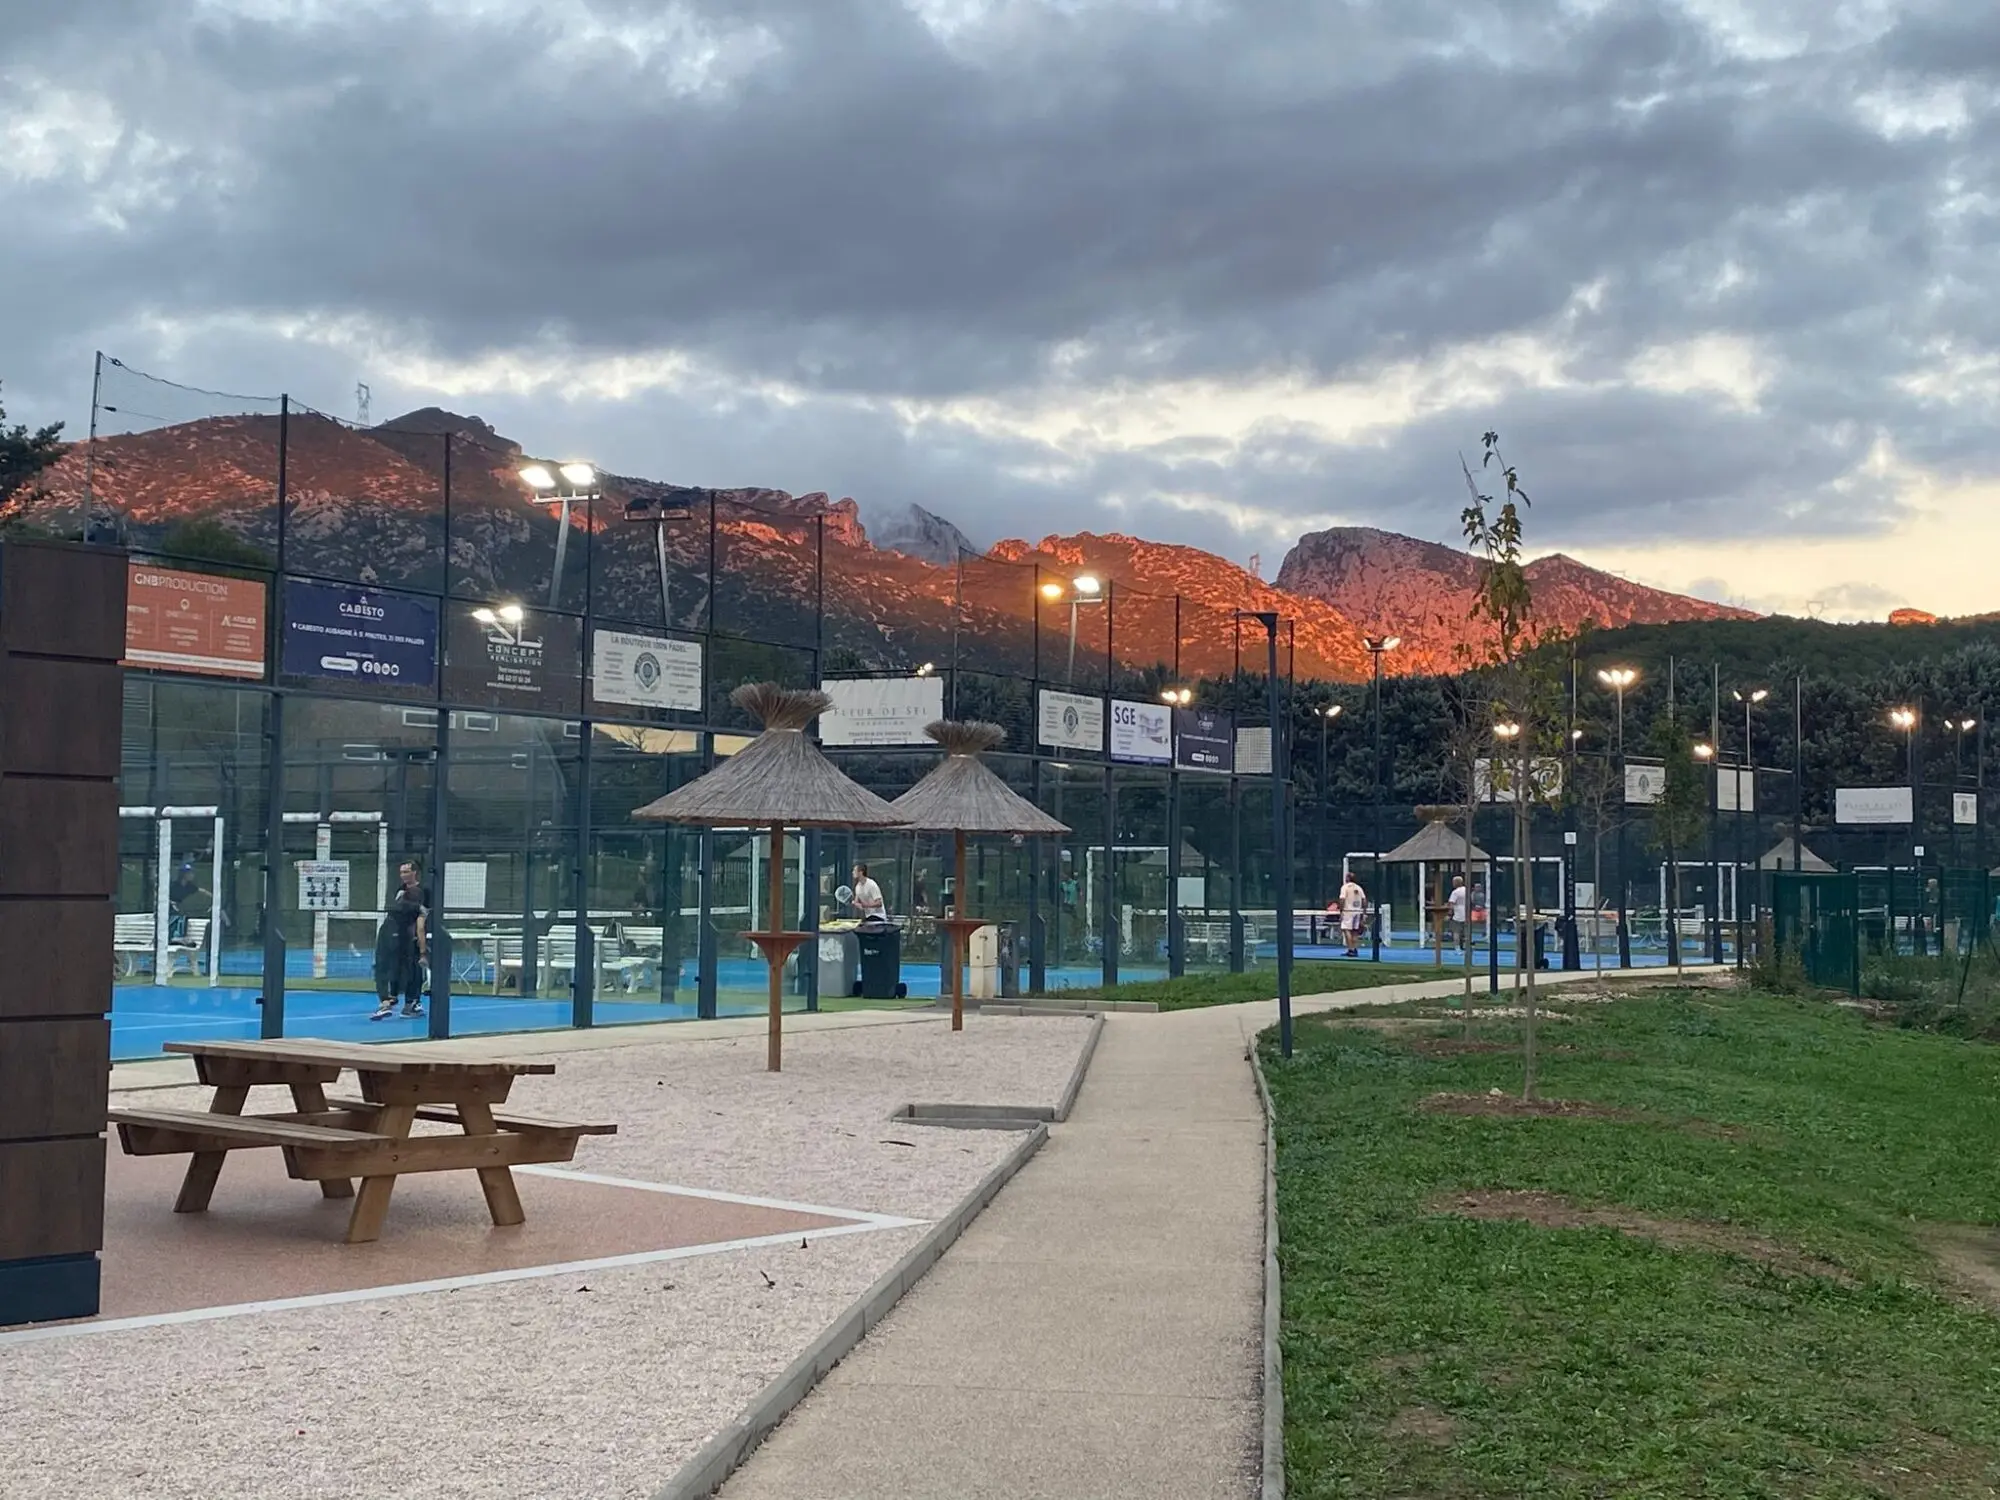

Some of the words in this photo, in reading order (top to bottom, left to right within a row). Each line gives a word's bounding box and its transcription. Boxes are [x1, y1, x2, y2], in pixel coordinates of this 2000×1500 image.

[339, 603, 385, 617] CABESTO
[298, 623, 324, 634] CABESTO
[486, 643, 544, 658] CONCEPT
[1114, 706, 1136, 726] SGE
